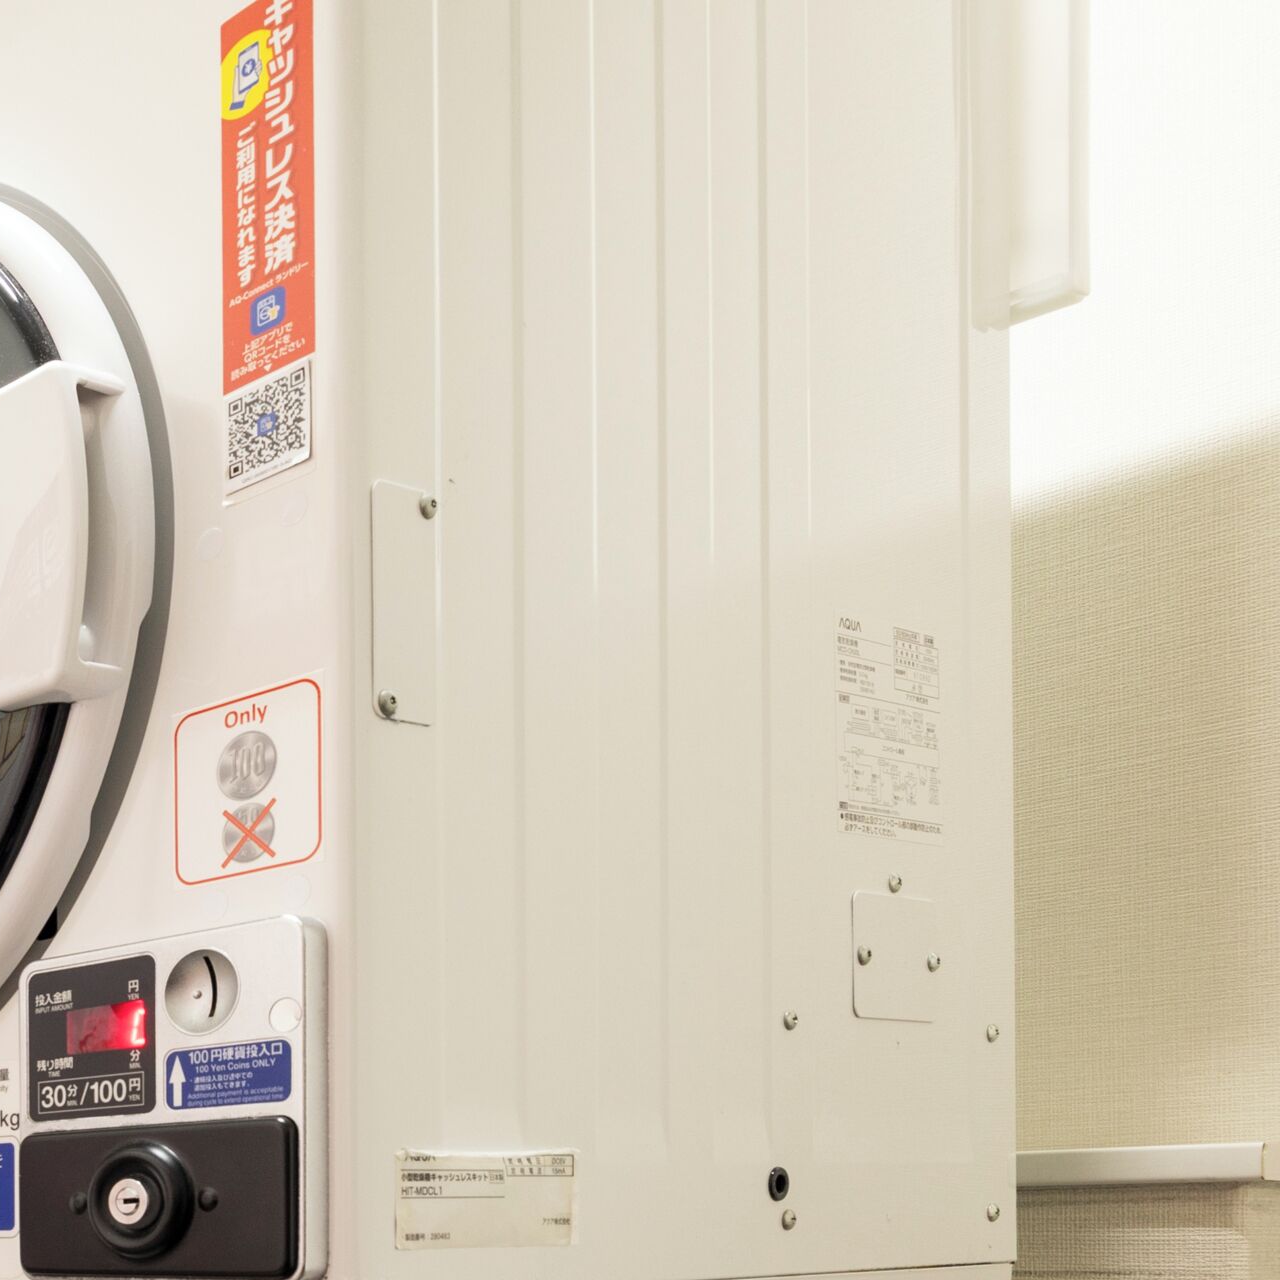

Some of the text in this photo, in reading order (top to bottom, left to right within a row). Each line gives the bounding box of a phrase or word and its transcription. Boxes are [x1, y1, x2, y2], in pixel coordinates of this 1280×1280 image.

[263, 0, 296, 275] キャッシュレス決済
[236, 122, 258, 287] ご利用になれます
[229, 261, 309, 308] AQ-Connect ランドリー
[243, 322, 293, 355] 上記アプリで
[244, 333, 291, 363] QRコードを
[231, 337, 306, 381] 読み取ってください
[839, 617, 861, 633] AQUA
[224, 703, 268, 728] Only
[35, 990, 72, 1007] 投入金額
[128, 980, 139, 992] 円
[37, 1057, 74, 1072] 残り時間
[130, 1050, 141, 1062] 分
[228, 1058, 276, 1070] Coins ONLY
